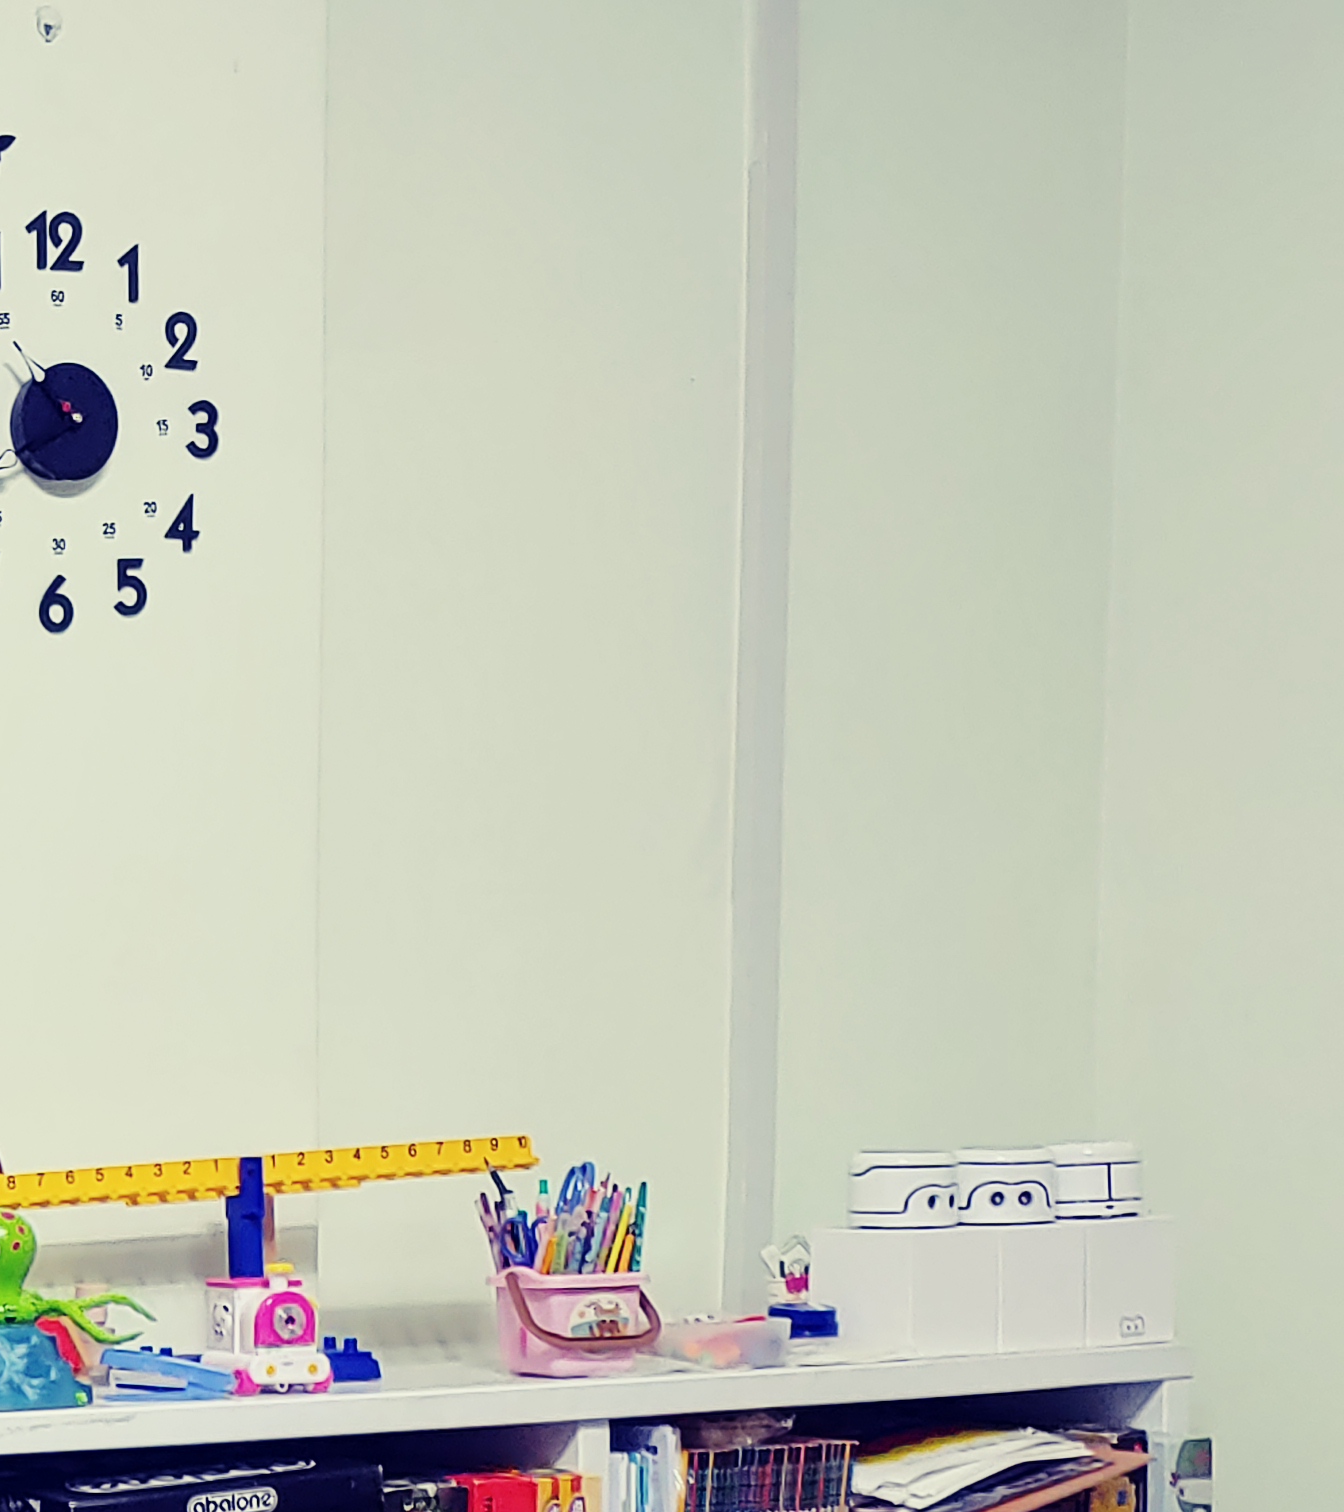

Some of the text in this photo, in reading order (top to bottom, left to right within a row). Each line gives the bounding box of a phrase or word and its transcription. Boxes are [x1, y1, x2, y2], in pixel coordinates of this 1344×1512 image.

[25, 210, 84, 272] 12
[117, 244, 139, 303] 1
[50, 290, 65, 303] 60
[115, 313, 123, 327] 5
[164, 311, 199, 371] 2
[140, 364, 153, 378] 10
[156, 419, 169, 433] 15
[185, 400, 219, 459] 3
[144, 501, 157, 515] 20
[164, 493, 200, 552] 4
[102, 522, 116, 536] 25
[51, 538, 66, 552] 30
[114, 558, 147, 617] 5
[38, 574, 74, 634] 6
[271, 1154, 277, 1168] 1
[296, 1151, 306, 1166] 2
[324, 1149, 334, 1164] 3
[352, 1147, 361, 1161] 4
[380, 1145, 390, 1159] 5
[408, 1143, 418, 1158] 6
[435, 1141, 445, 1156] 7
[462, 1139, 472, 1153] 8
[489, 1137, 499, 1152] 9
[6, 1175, 16, 1190] 8
[36, 1172, 46, 1187] 7
[65, 1170, 76, 1184] 6
[95, 1167, 105, 1182] 5
[124, 1165, 134, 1179] 4
[153, 1163, 163, 1177] 3
[183, 1160, 192, 1175] 2
[213, 1158, 219, 1173] 1
